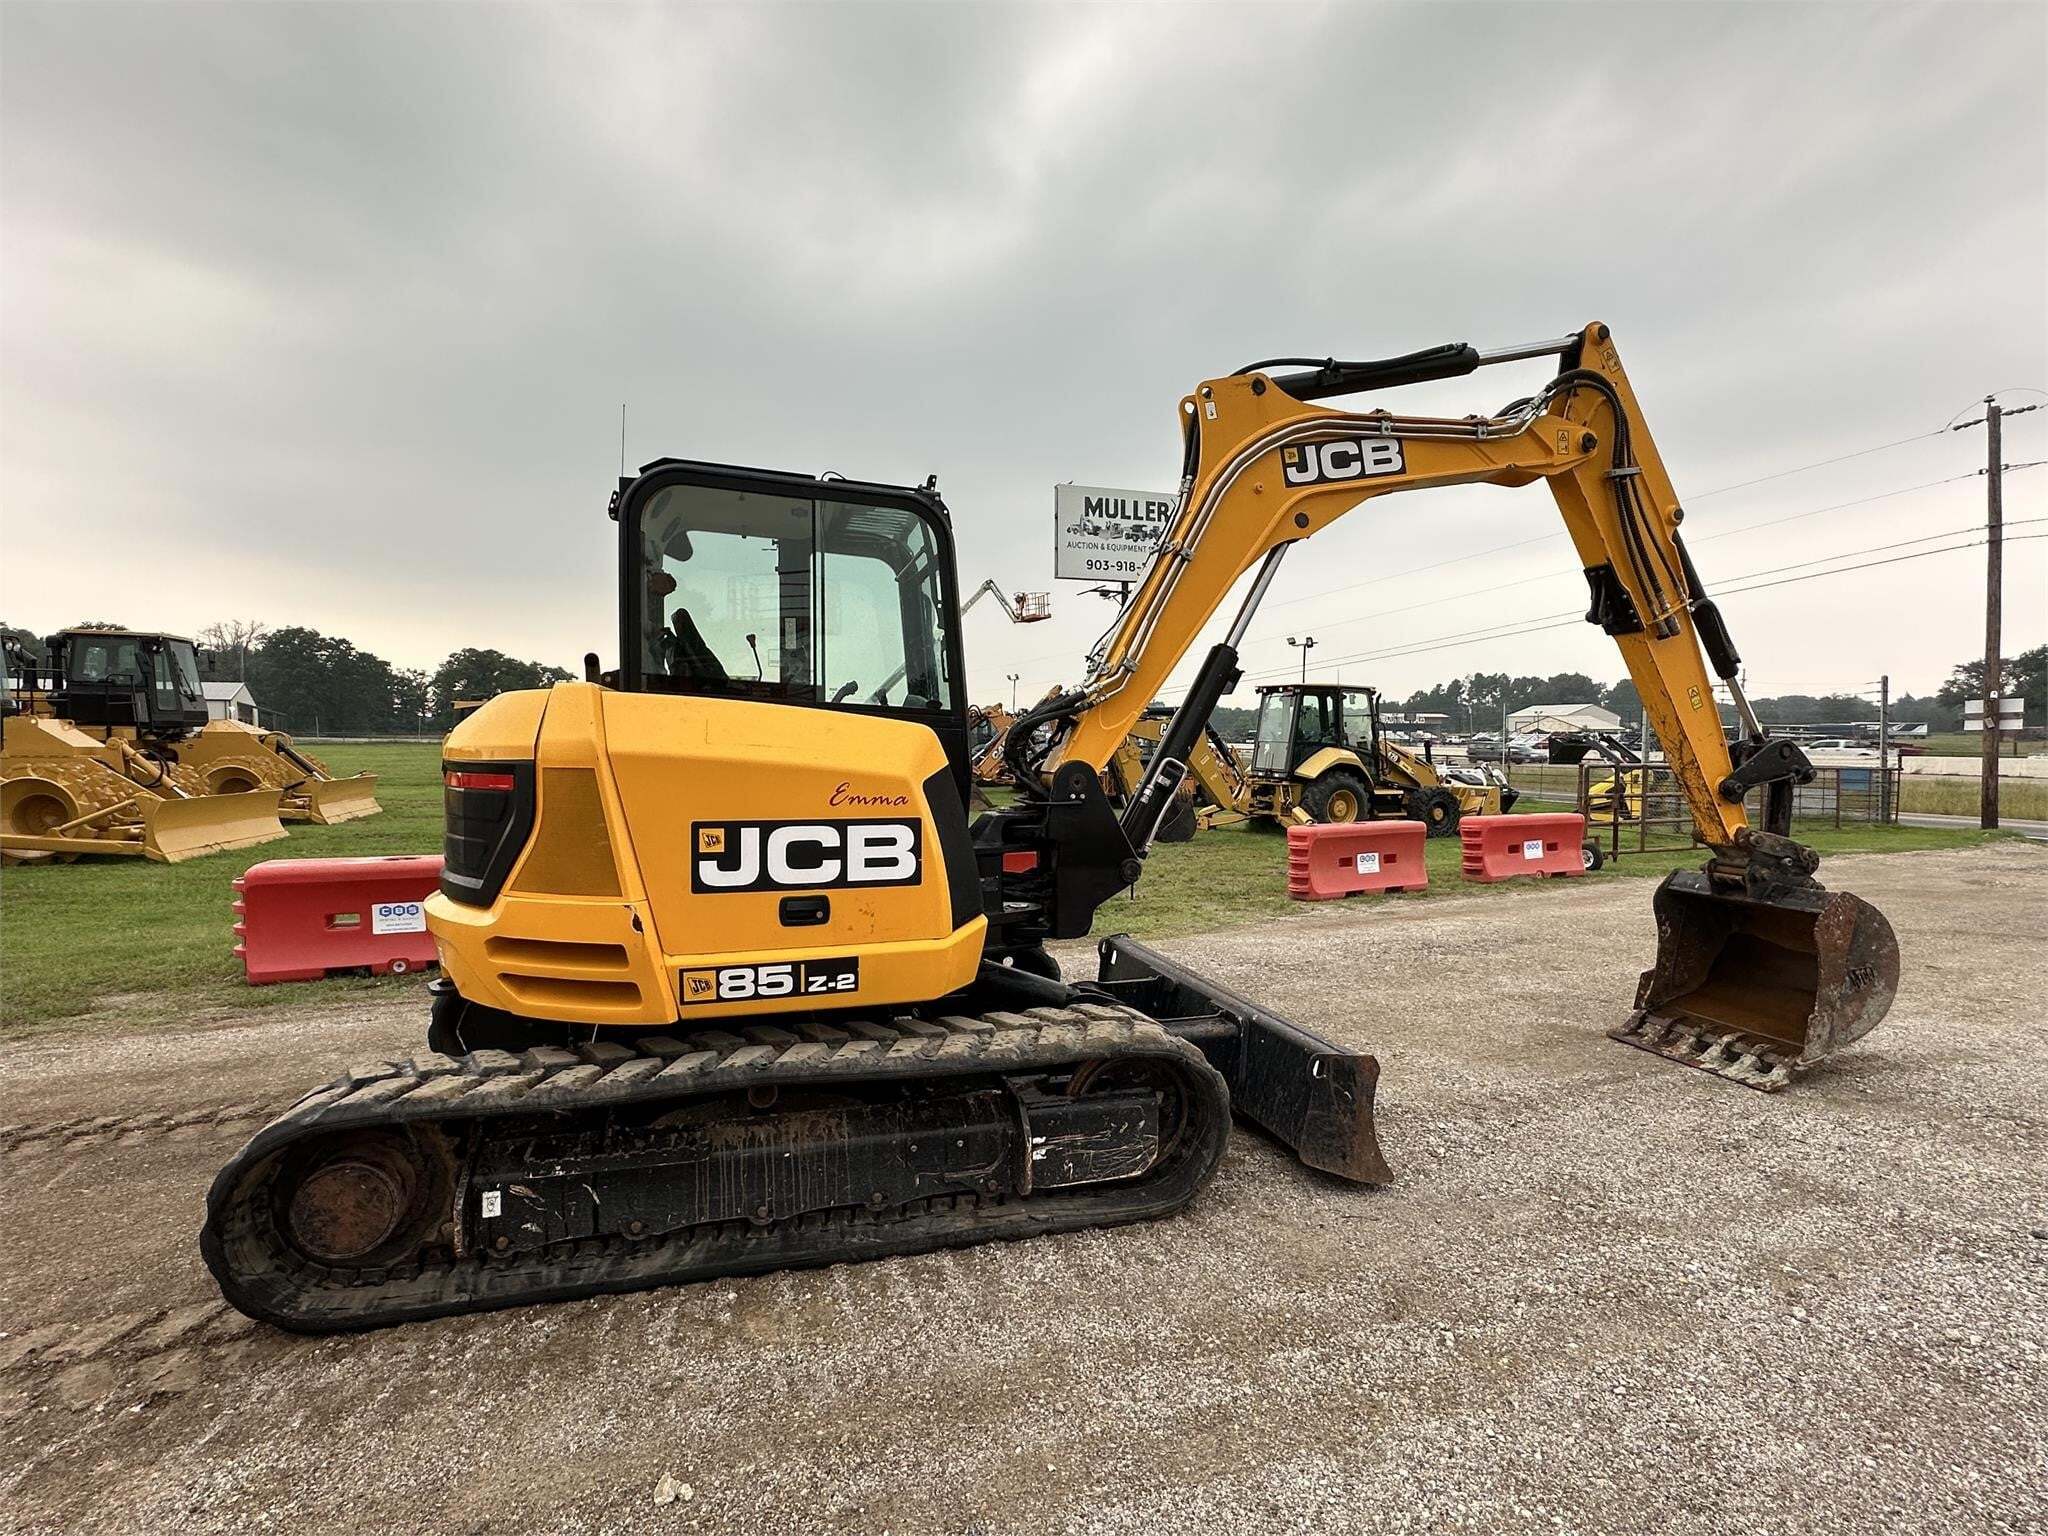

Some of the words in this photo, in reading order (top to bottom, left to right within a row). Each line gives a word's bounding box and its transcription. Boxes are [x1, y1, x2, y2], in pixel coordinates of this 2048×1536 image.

[1286, 438, 1403, 483] JCB
[1084, 496, 1169, 521] MULLER
[1066, 541, 1099, 551] AUCTION
[1099, 543, 1106, 551] &
[1106, 543, 1147, 552] EQUIPMENT
[829, 782, 909, 806] Emma
[698, 824, 917, 887] JCB
[718, 965, 794, 999] 85
[807, 973, 856, 992] Z-2
